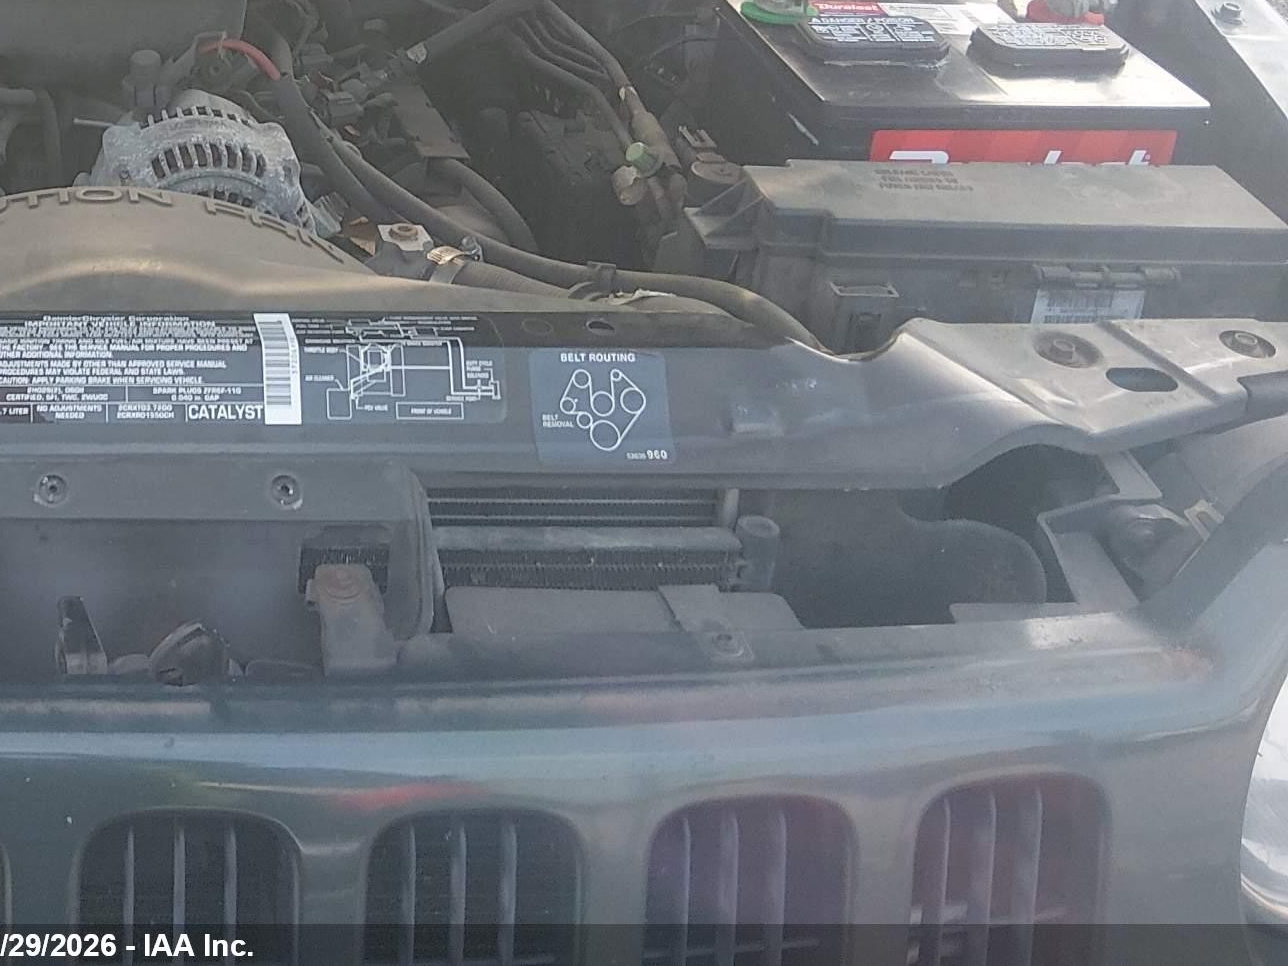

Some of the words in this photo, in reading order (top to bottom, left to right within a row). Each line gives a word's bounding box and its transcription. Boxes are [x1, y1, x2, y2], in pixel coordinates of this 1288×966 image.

[205, 198, 346, 265] FAN
[560, 353, 586, 362] BELT
[589, 353, 636, 362] ROUTING
[196, 360, 226, 368] MANUAL
[8, 408, 29, 416] LITER
[188, 405, 264, 419] CATALYST
